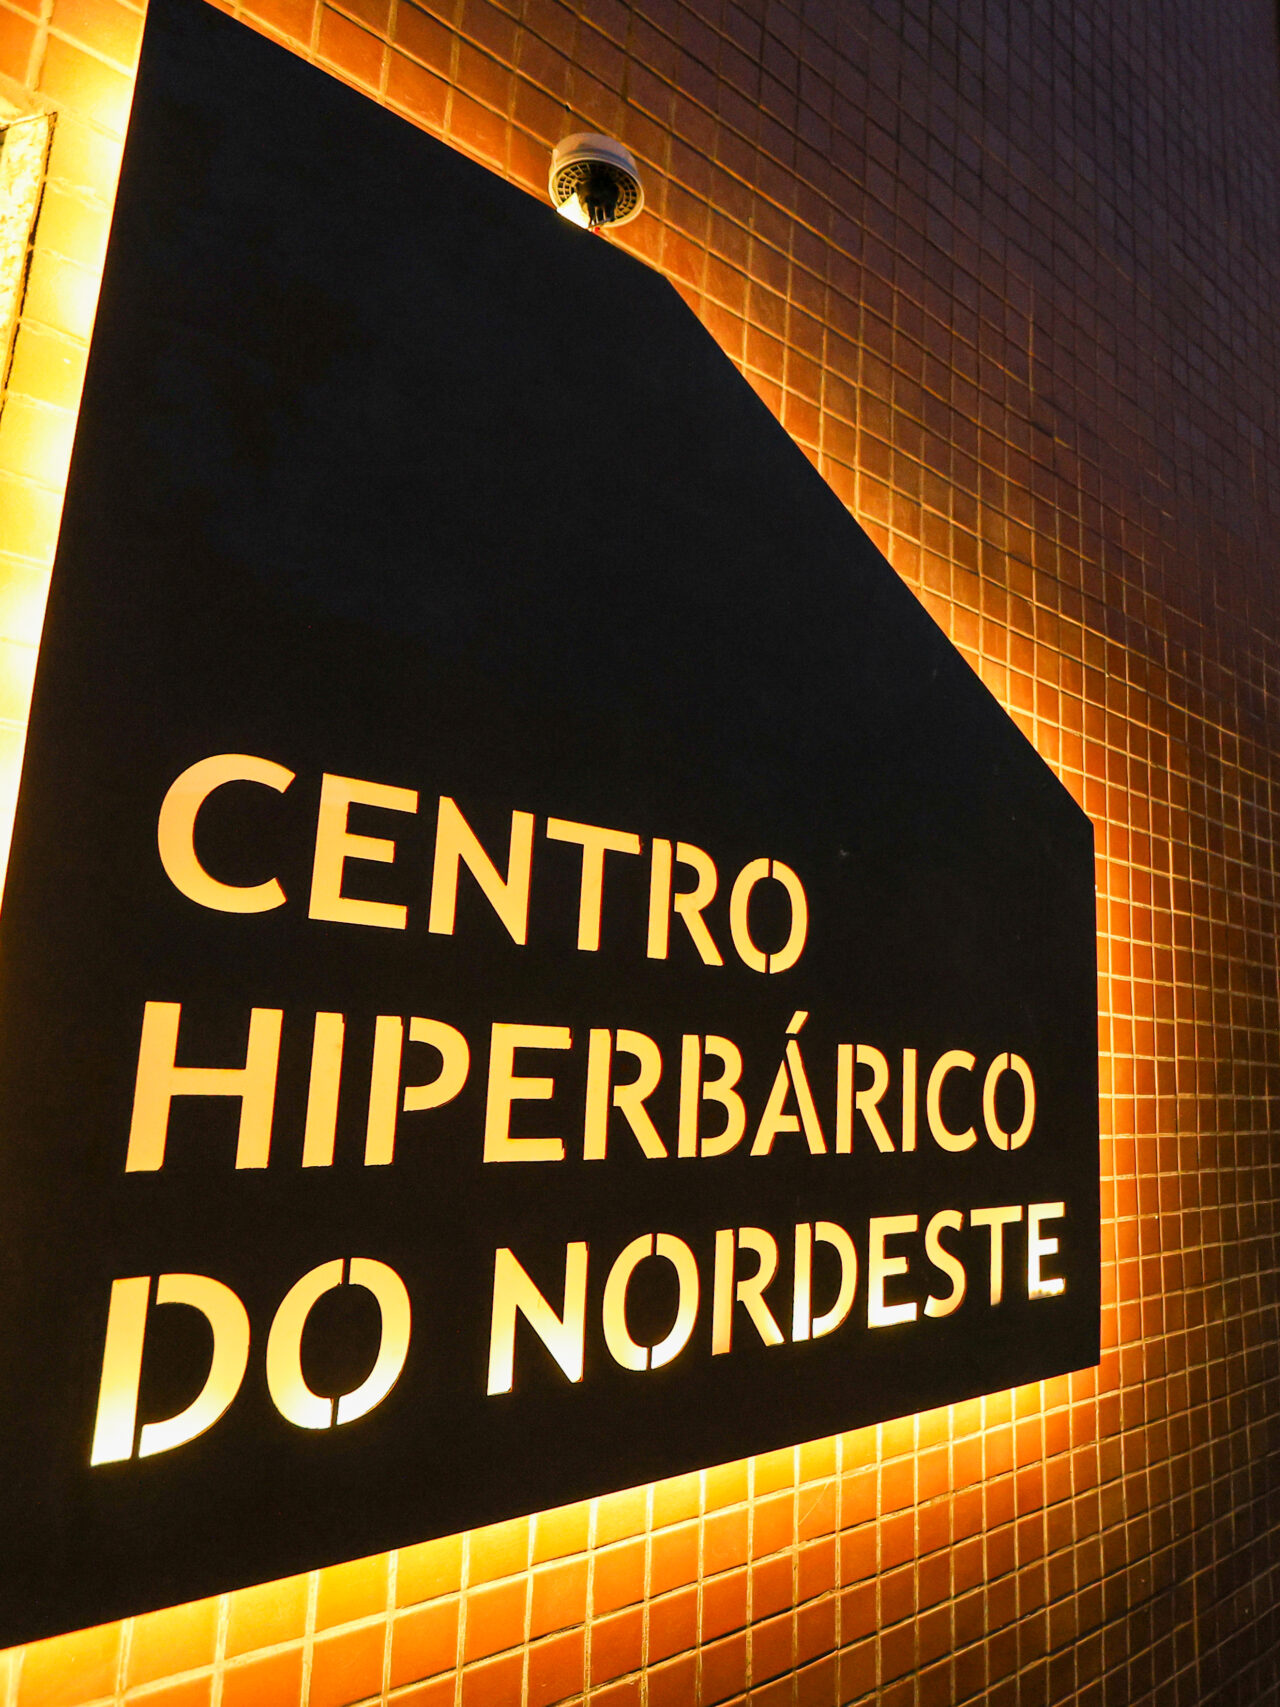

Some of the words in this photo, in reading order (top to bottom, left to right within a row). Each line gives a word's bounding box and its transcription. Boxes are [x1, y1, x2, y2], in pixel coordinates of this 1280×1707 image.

[157, 753, 810, 975] CENTRO
[124, 1001, 1037, 1173] HIPERBÁRICO
[90, 1256, 413, 1467] DO
[486, 1201, 1067, 1397] NORDESTE
